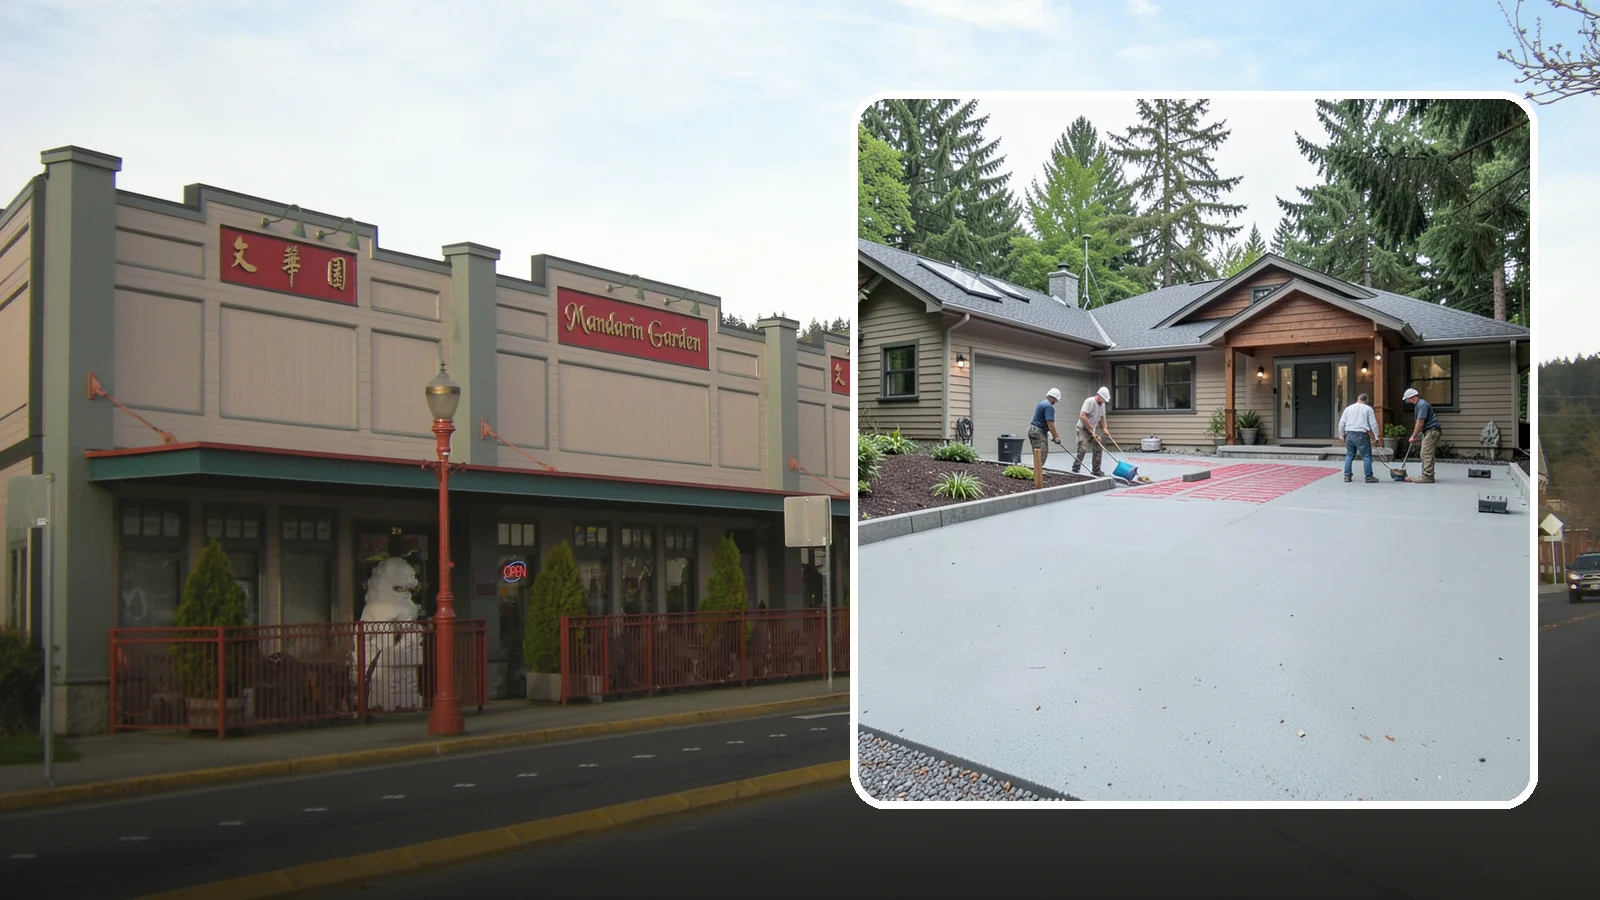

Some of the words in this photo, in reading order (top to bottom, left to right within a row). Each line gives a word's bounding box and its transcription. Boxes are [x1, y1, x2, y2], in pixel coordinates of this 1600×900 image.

[231, 236, 346, 290] 文華園
[564, 302, 644, 340] Mandarin
[648, 320, 701, 352] Garden
[503, 565, 527, 578] OPEN
